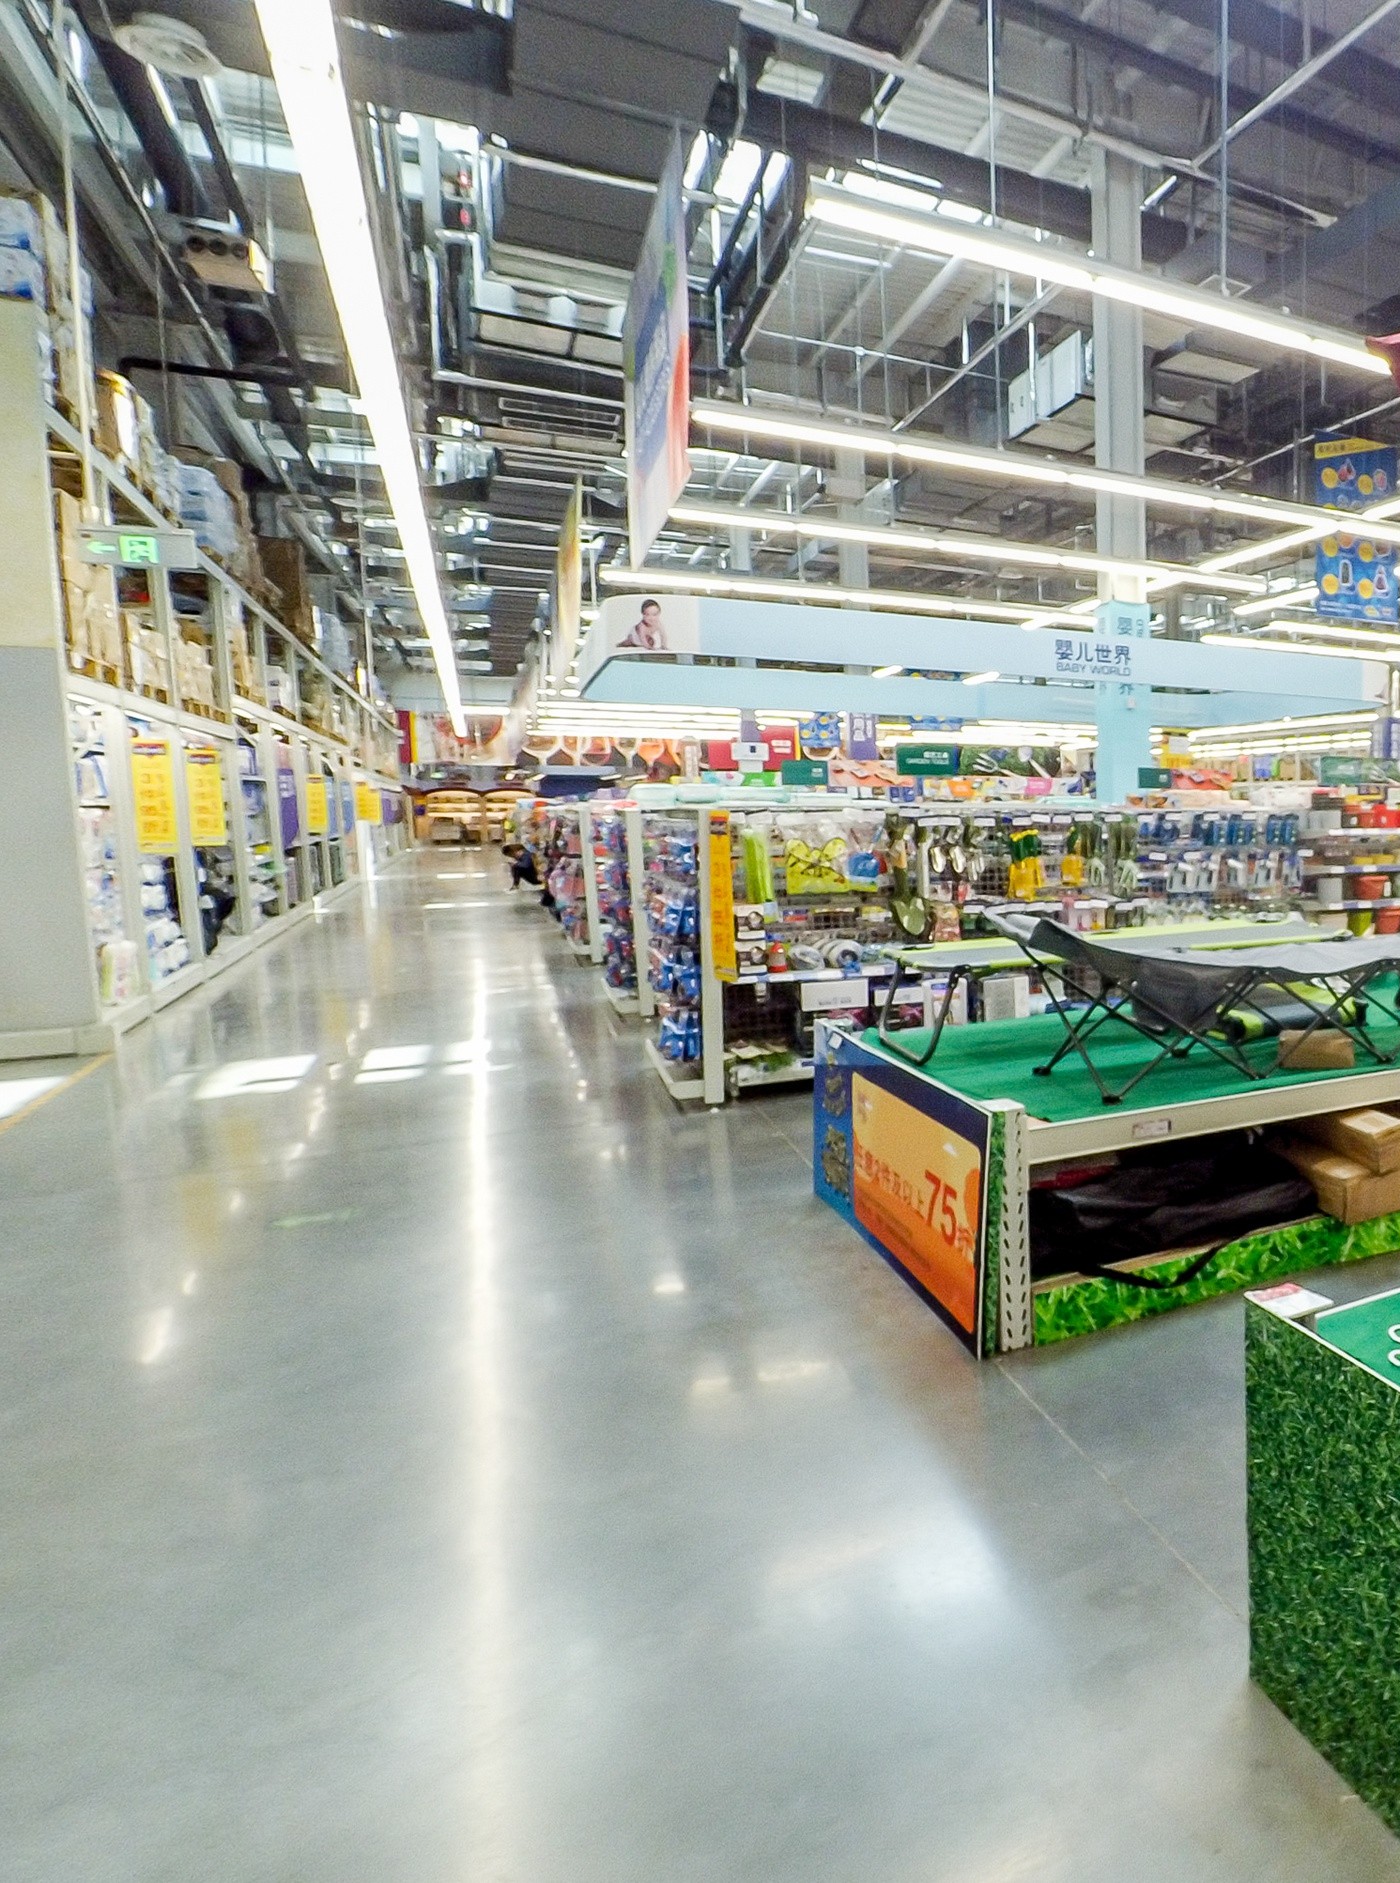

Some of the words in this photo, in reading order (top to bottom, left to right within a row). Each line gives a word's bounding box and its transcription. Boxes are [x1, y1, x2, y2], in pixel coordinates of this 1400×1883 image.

[1055, 639, 1131, 665] 婴儿世界
[1056, 662, 1087, 673] BABY
[1090, 665, 1131, 676] WORLD
